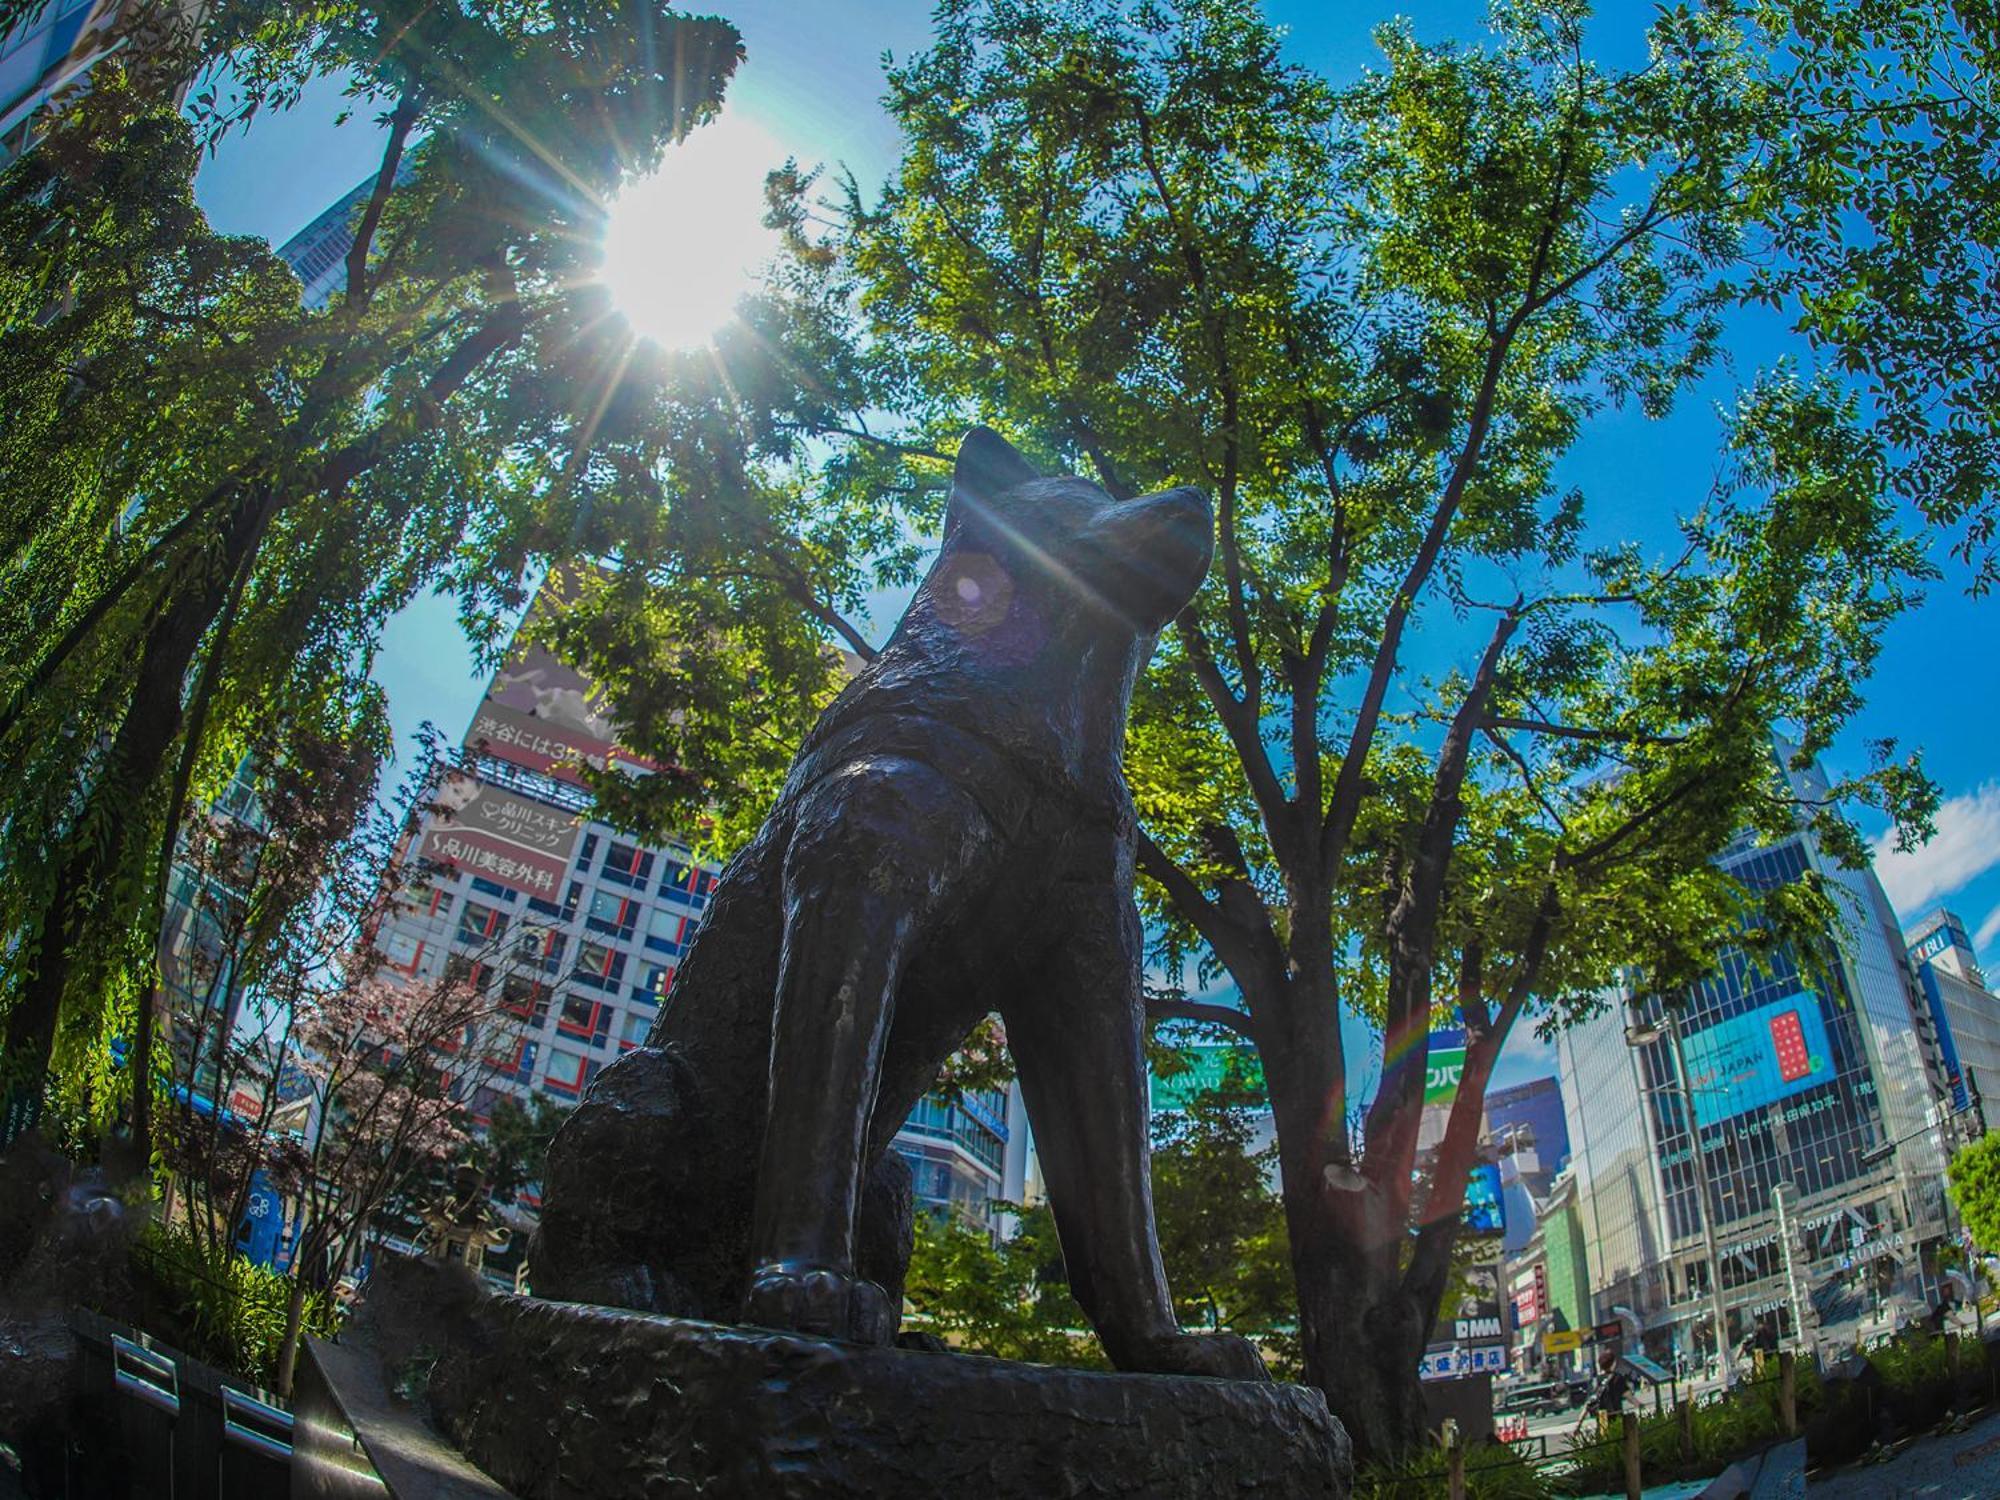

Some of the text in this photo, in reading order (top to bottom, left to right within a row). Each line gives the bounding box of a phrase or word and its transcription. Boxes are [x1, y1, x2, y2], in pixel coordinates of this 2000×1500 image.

[497, 817, 560, 847] クリニック
[500, 801, 574, 837] 品川スキン
[442, 838, 554, 891] 品川美容外科
[1717, 1231, 1781, 1259] STARBUC
[1455, 1317, 1502, 1339] DMM
